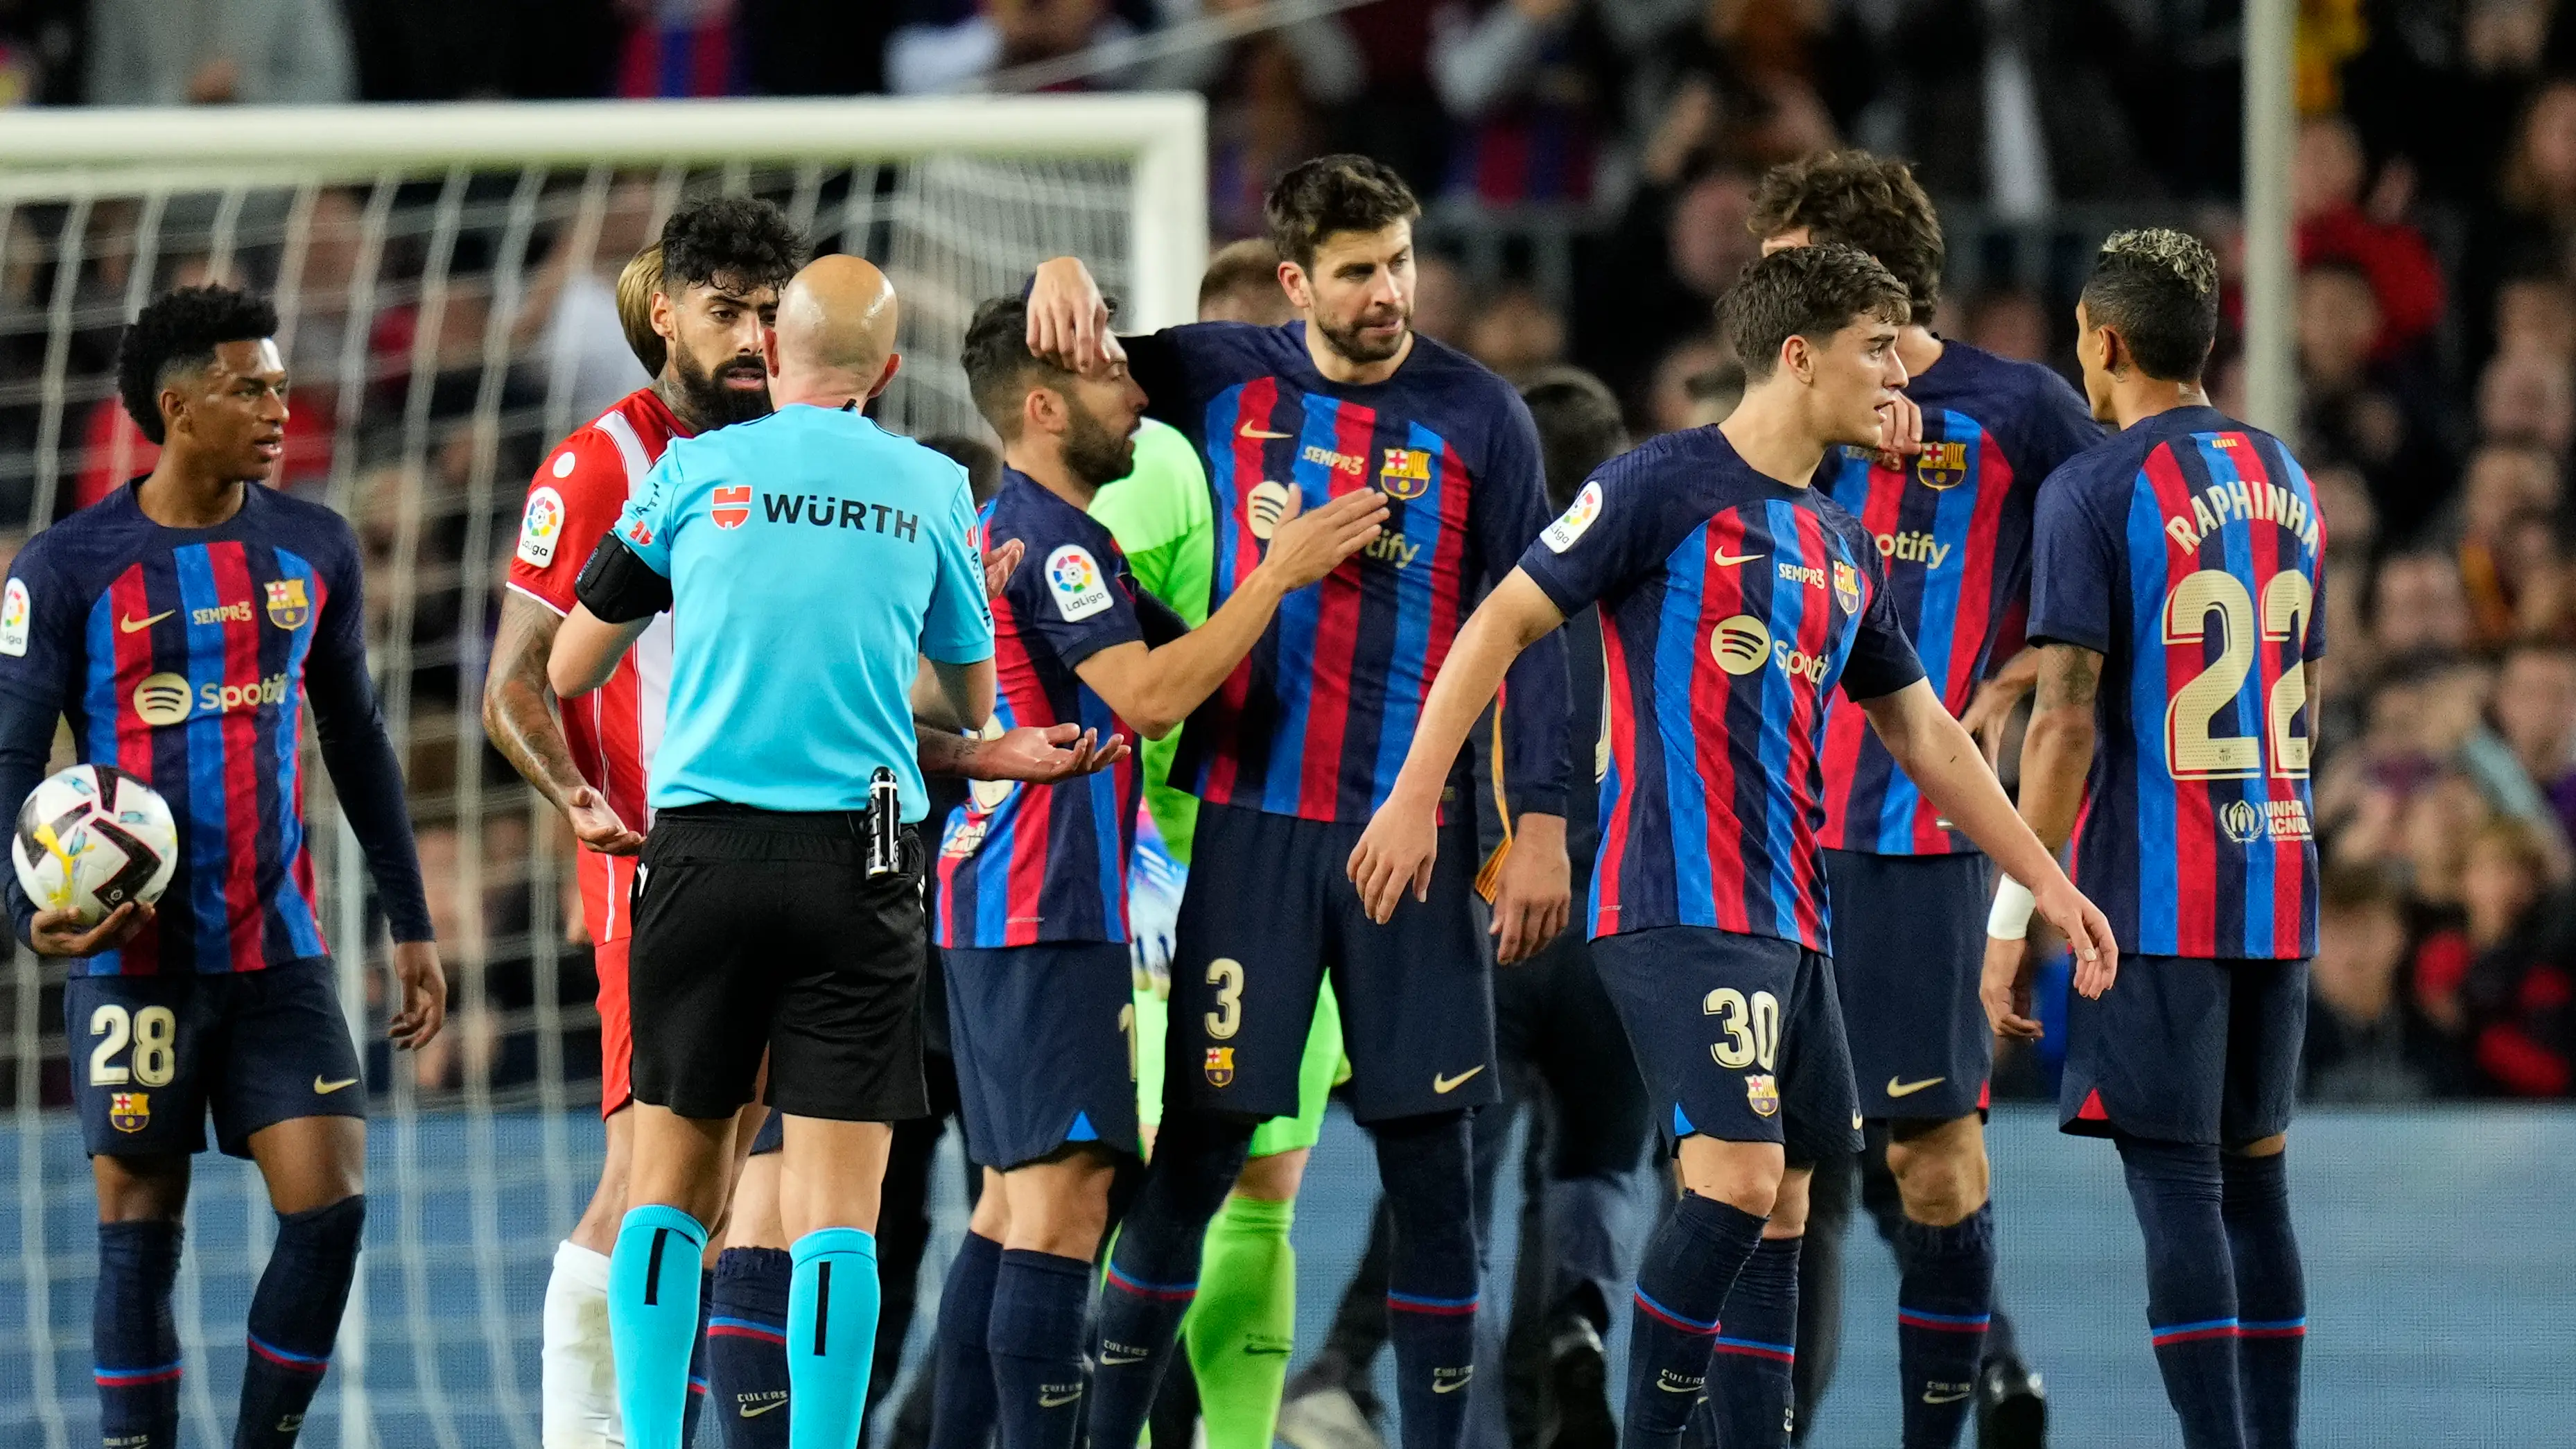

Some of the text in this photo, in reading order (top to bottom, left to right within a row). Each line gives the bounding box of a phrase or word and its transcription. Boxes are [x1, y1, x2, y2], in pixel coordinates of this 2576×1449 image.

[1302, 445, 1365, 476] SEMPR3
[763, 493, 919, 544] WÜRTH
[1549, 524, 1570, 544] Liga
[2165, 480, 2319, 557] RAPHINHA
[1365, 529, 1421, 569] tify
[1875, 530, 1951, 569] otify
[1778, 562, 1825, 590] SEMPR3
[192, 601, 253, 625] SEMPR3
[1065, 592, 1104, 611] LaLiga
[1774, 640, 1831, 685] Spoti
[2161, 569, 2310, 781] 22
[1204, 957, 1245, 1040] 3
[89, 1004, 176, 1088] 28
[1117, 1003, 1138, 1082] 1
[1703, 987, 1779, 1071] 30
[737, 1390, 788, 1403] CULERS
[1662, 1369, 1706, 1385] CULERS
